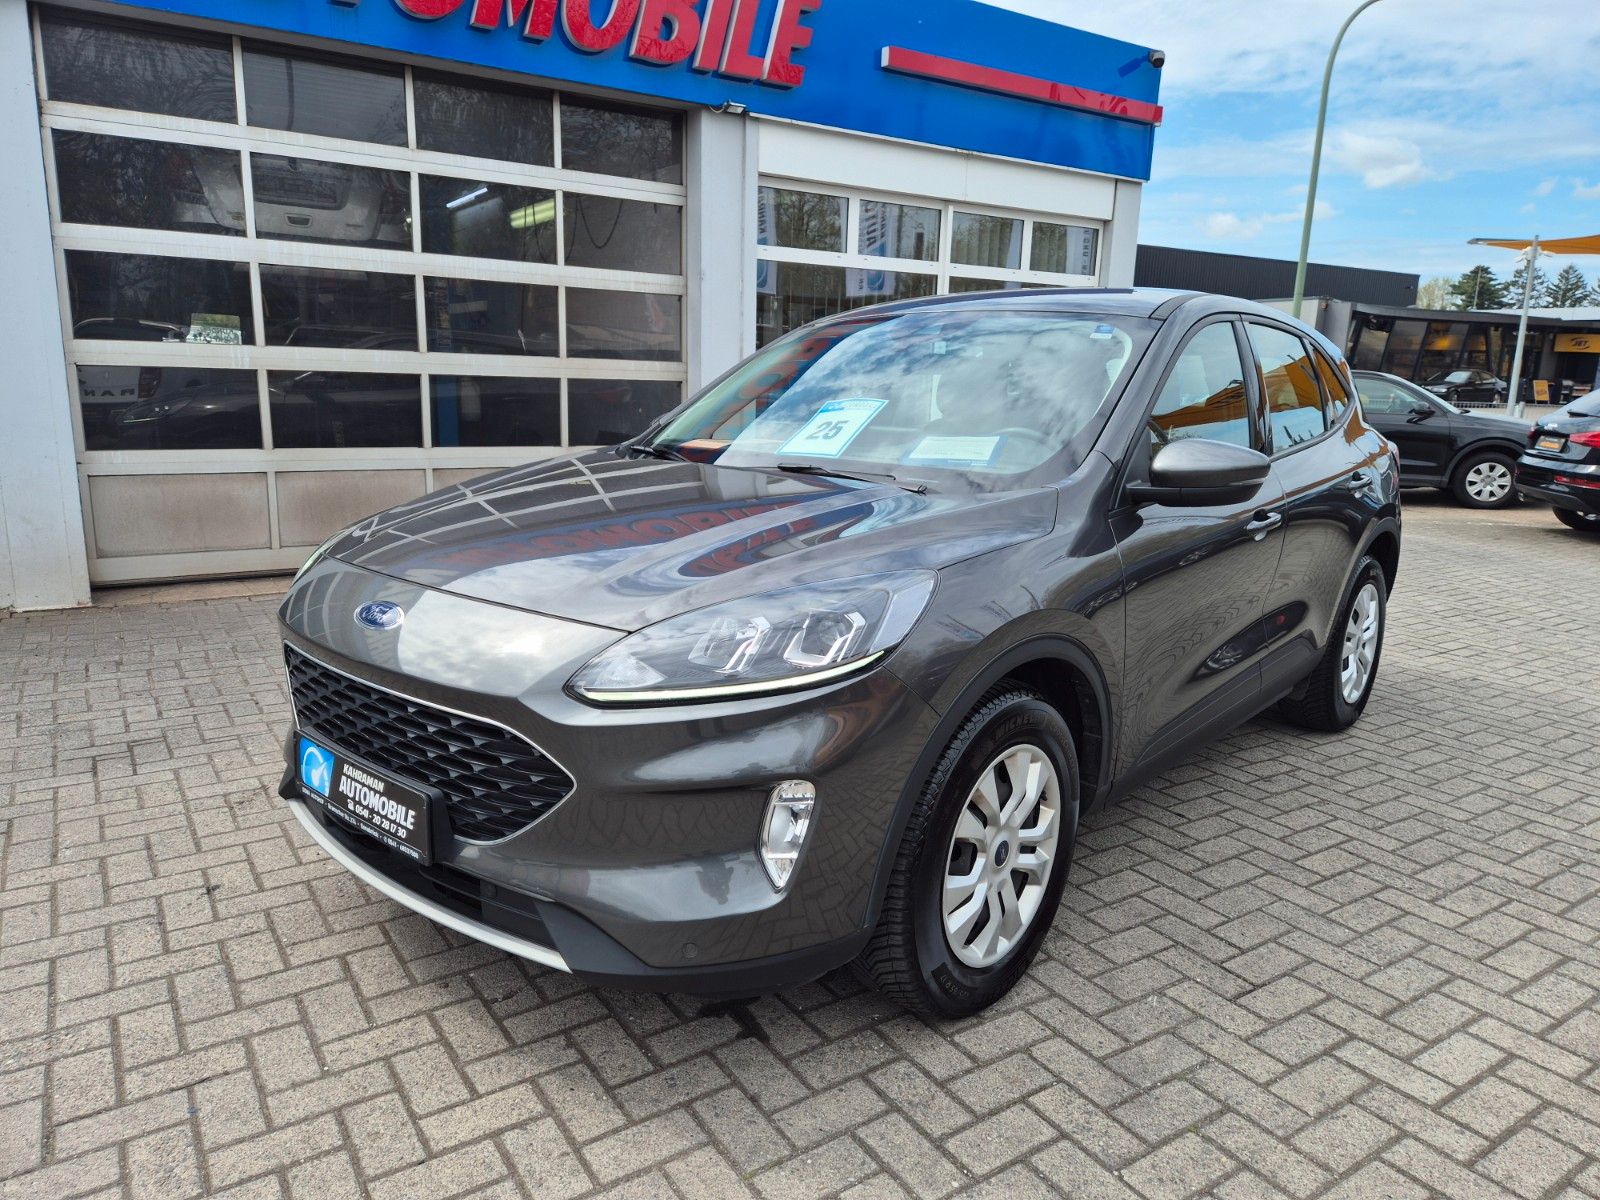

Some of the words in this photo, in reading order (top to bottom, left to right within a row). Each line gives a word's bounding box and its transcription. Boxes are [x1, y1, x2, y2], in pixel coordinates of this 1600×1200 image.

[328, 0, 820, 87] OBILE
[806, 420, 849, 440] 25
[343, 763, 385, 792] KAHRAMAN
[339, 775, 416, 830] AUTOMOBILE
[372, 814, 381, 825] 20
[397, 827, 407, 839] 30
